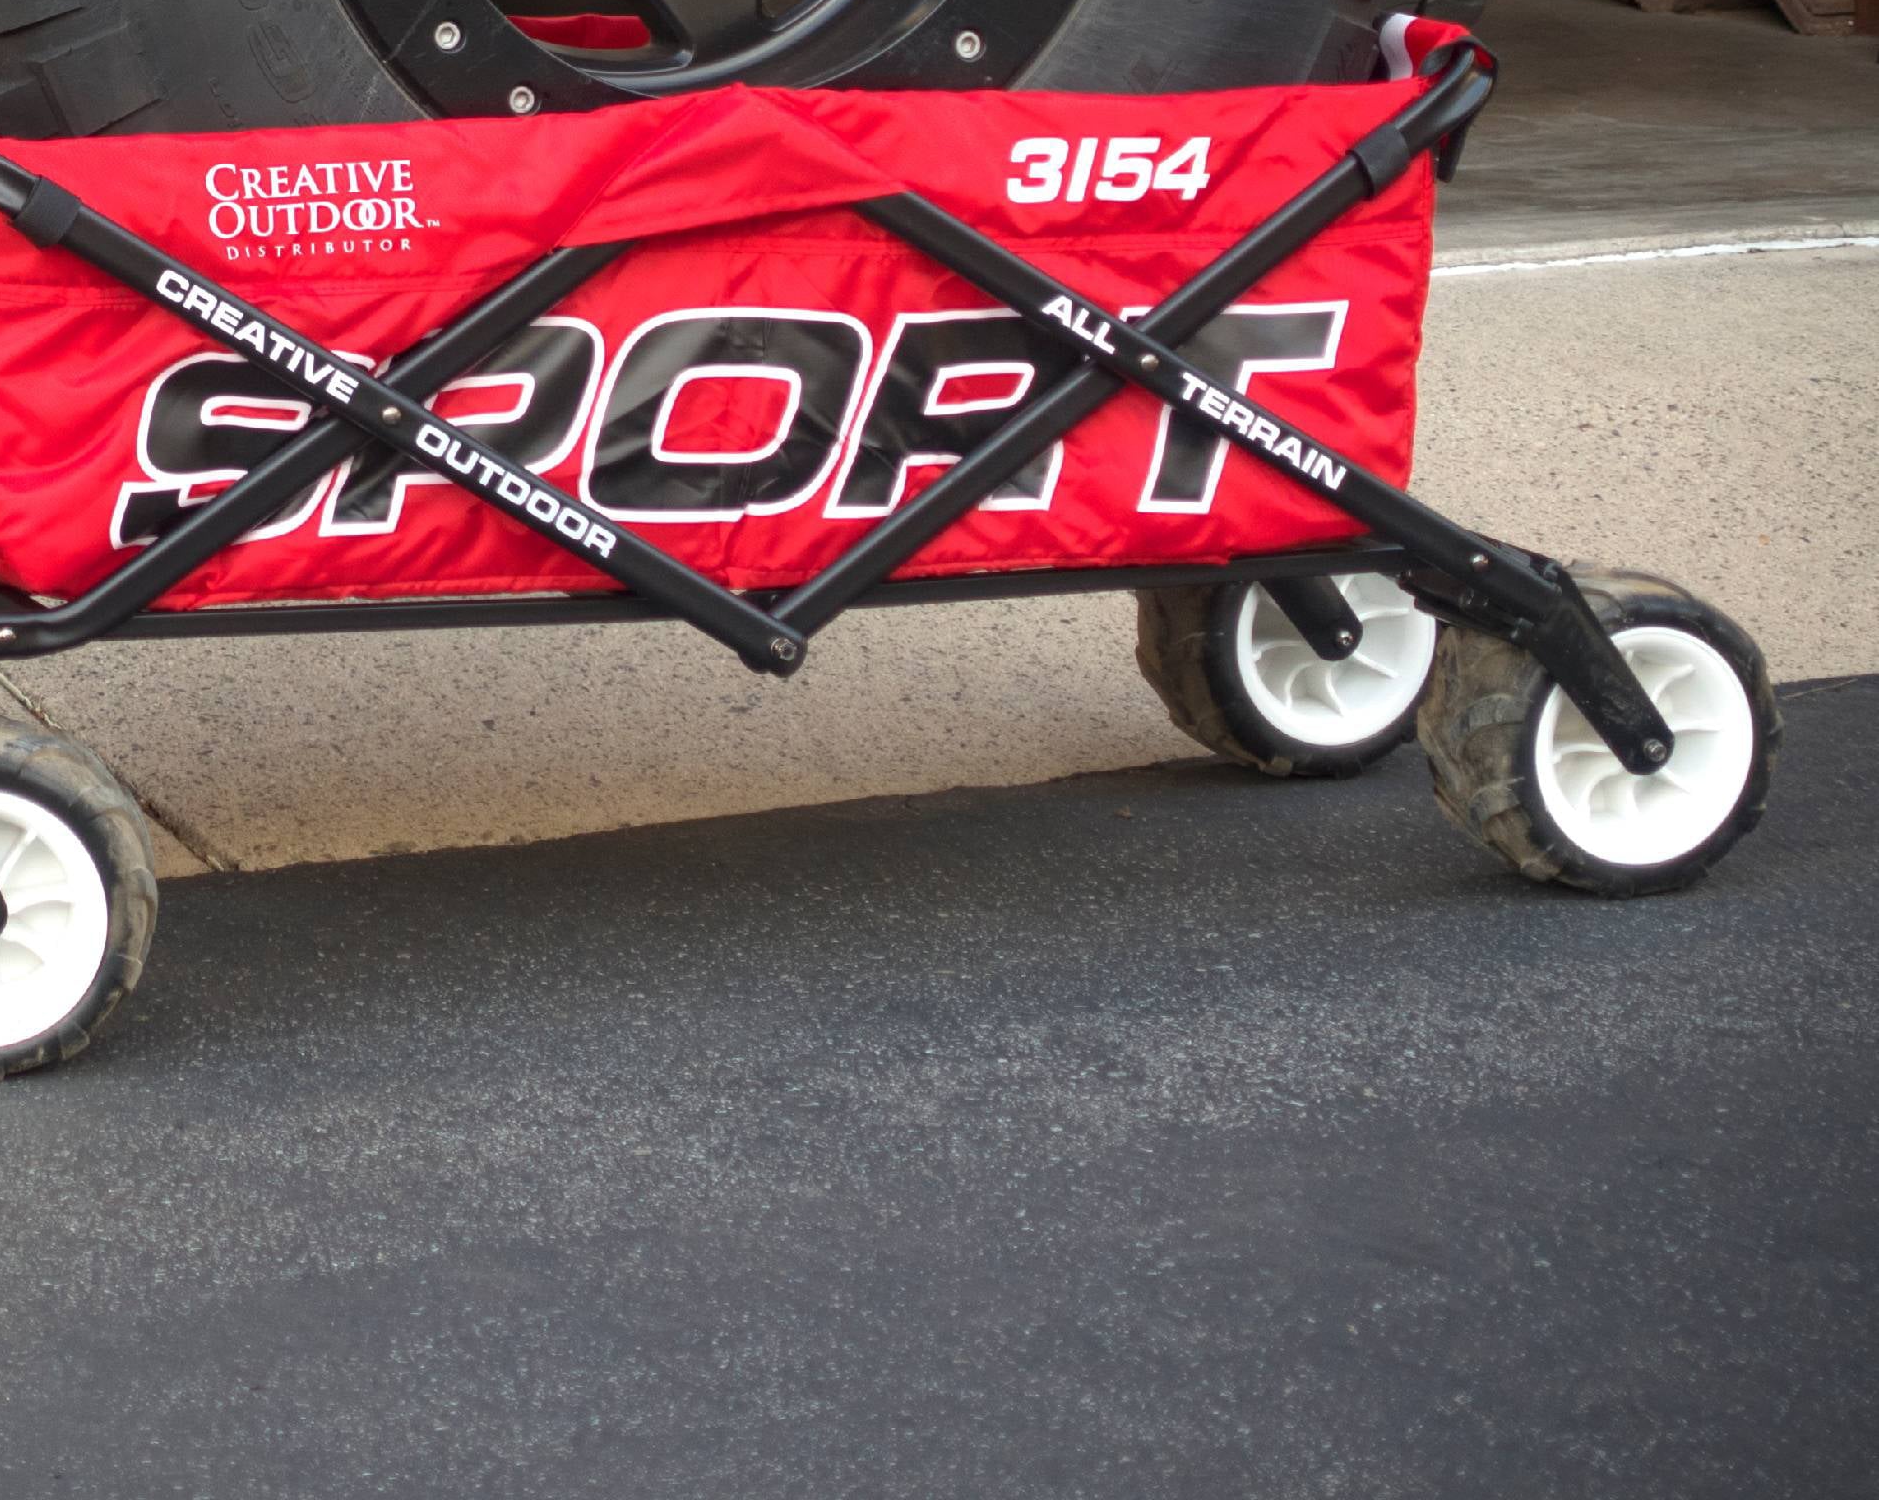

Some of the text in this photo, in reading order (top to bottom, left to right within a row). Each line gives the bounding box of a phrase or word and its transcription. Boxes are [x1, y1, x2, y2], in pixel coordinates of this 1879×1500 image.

[205, 159, 414, 201] CREATIVE
[1006, 136, 1210, 203] 3154
[208, 198, 424, 239] OUTDOOR
[227, 238, 414, 261] DISTRIBUTOR
[110, 299, 1350, 551] SPORT
[155, 269, 619, 559] CREATIVE OUTDOOR
[1041, 295, 1348, 491] ALL TERRAIN
